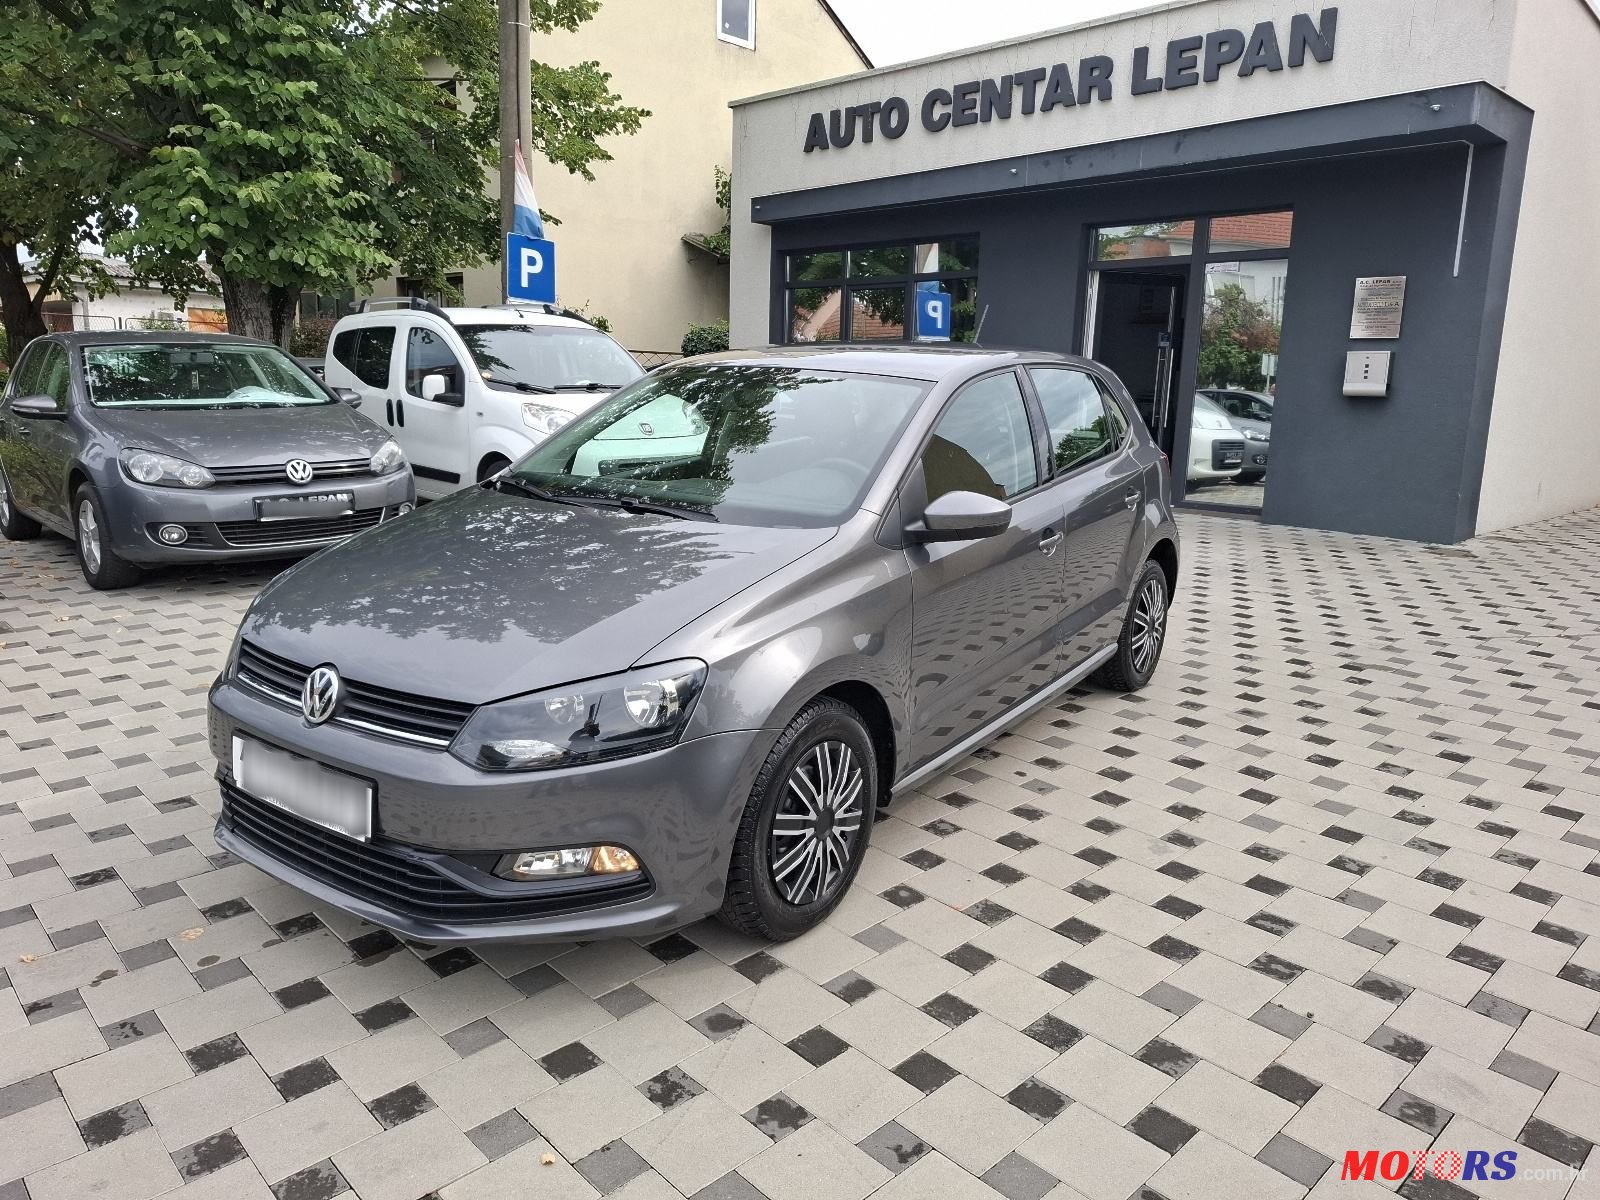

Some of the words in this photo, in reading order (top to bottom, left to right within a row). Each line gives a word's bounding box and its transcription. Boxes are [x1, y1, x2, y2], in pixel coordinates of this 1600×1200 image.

[803, 97, 909, 153] AUTO
[921, 55, 1113, 132] CENTAR
[1131, 7, 1338, 96] LEPAN
[521, 247, 543, 288] P
